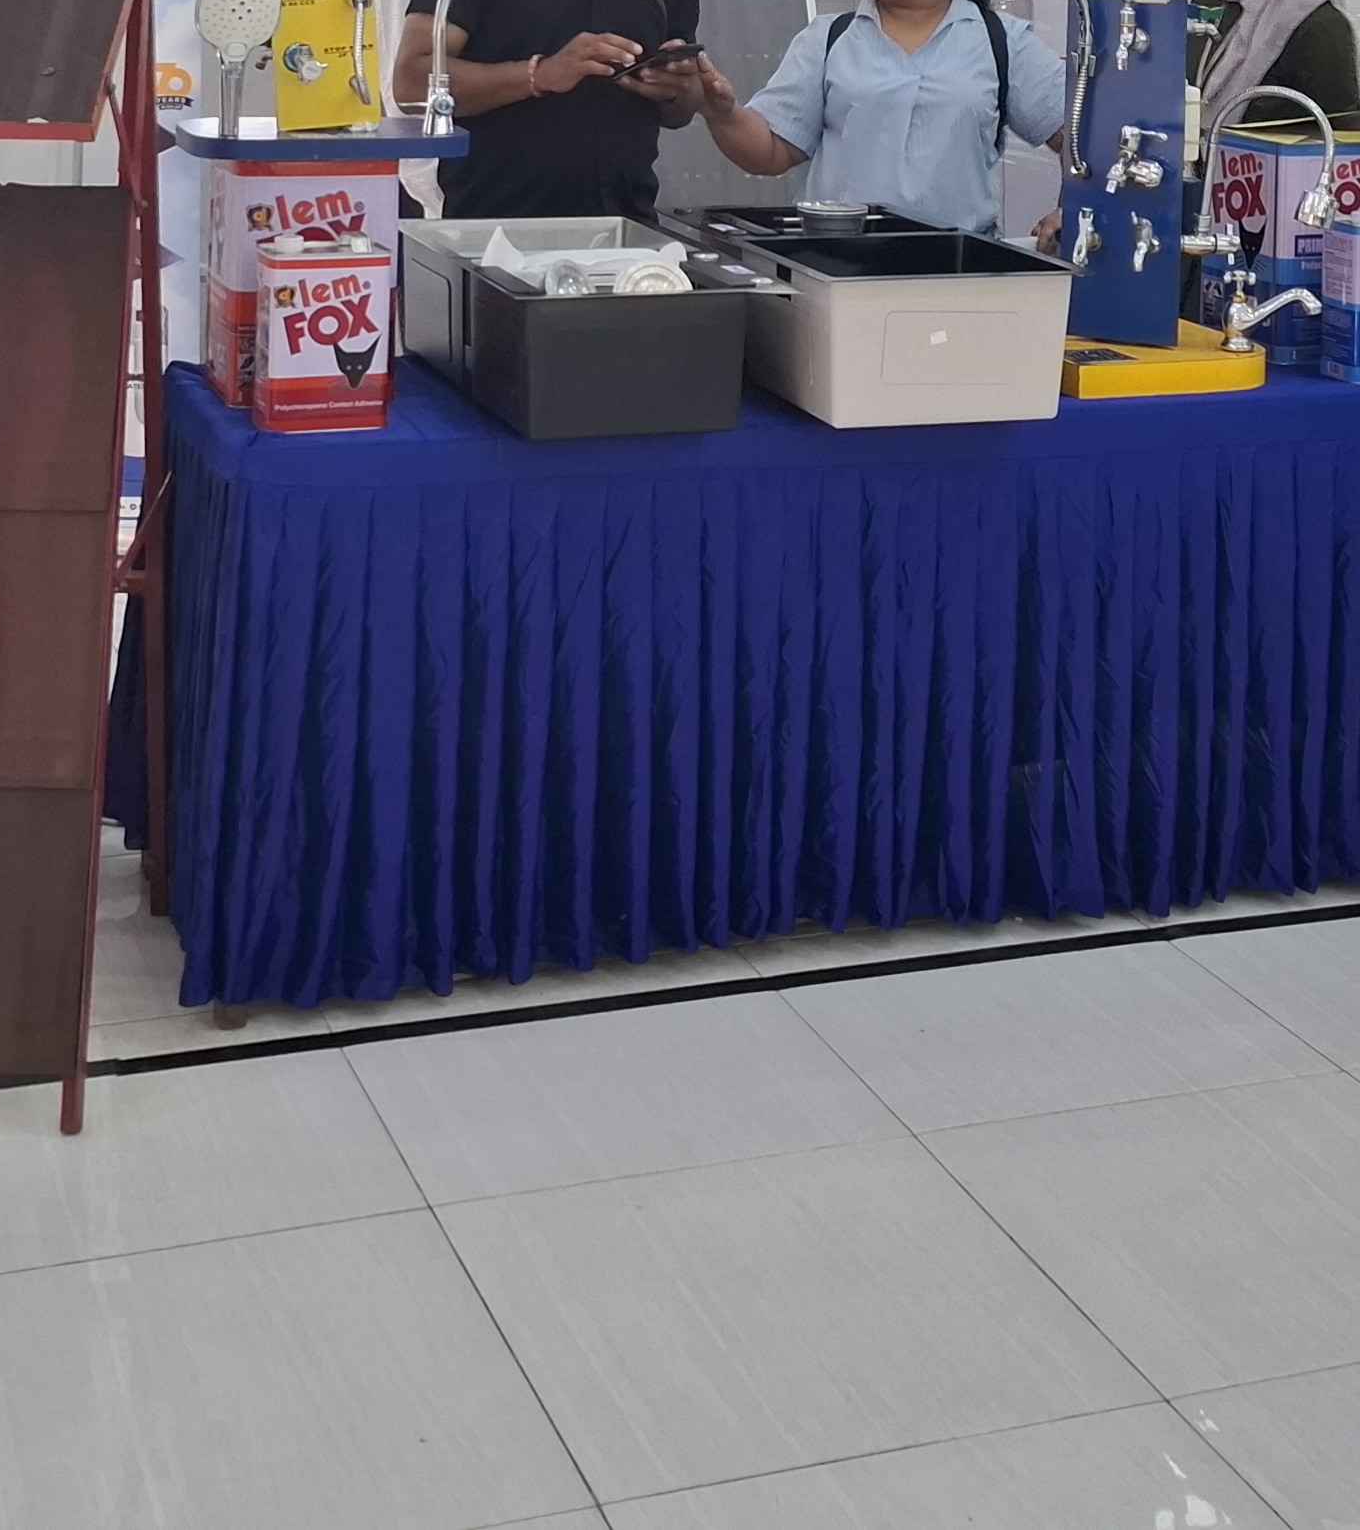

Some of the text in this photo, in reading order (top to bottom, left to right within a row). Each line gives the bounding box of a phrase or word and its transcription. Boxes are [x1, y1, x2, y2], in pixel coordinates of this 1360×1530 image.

[1221, 150, 1257, 179] lem
[275, 190, 352, 230] lem
[1212, 174, 1267, 224] FOX
[297, 273, 361, 308] lem
[283, 293, 381, 355] FOX
